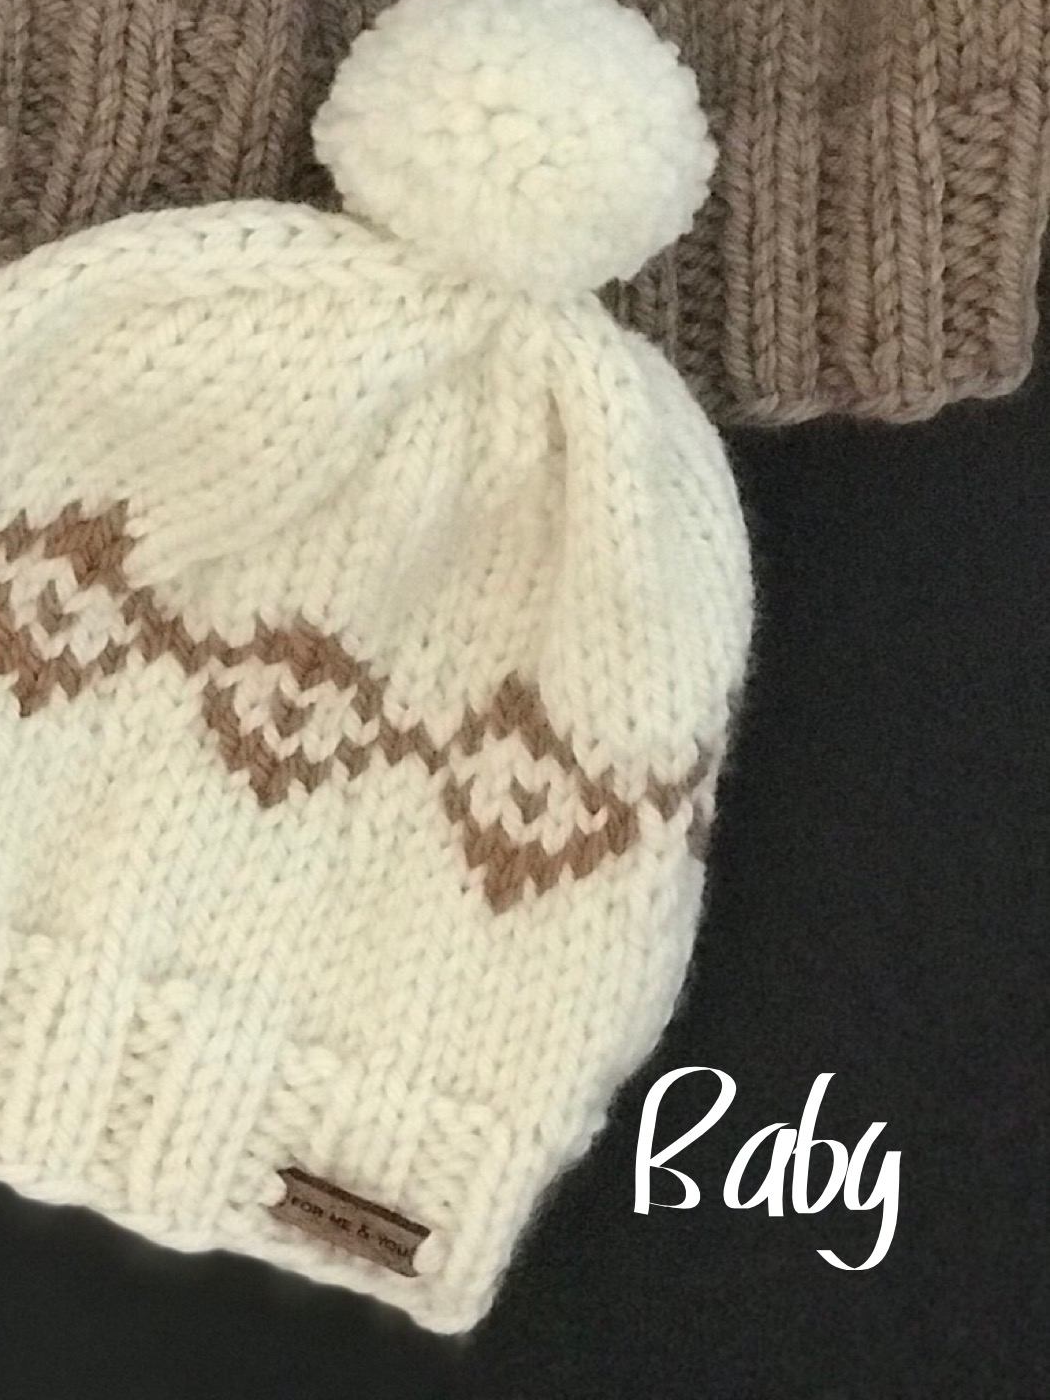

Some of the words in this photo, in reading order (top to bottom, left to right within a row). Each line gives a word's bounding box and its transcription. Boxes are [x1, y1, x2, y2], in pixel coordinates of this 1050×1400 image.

[290, 1197, 324, 1218] FOR
[329, 1212, 351, 1232] ME
[357, 1224, 370, 1240] &
[378, 1236, 409, 1257] YOU
